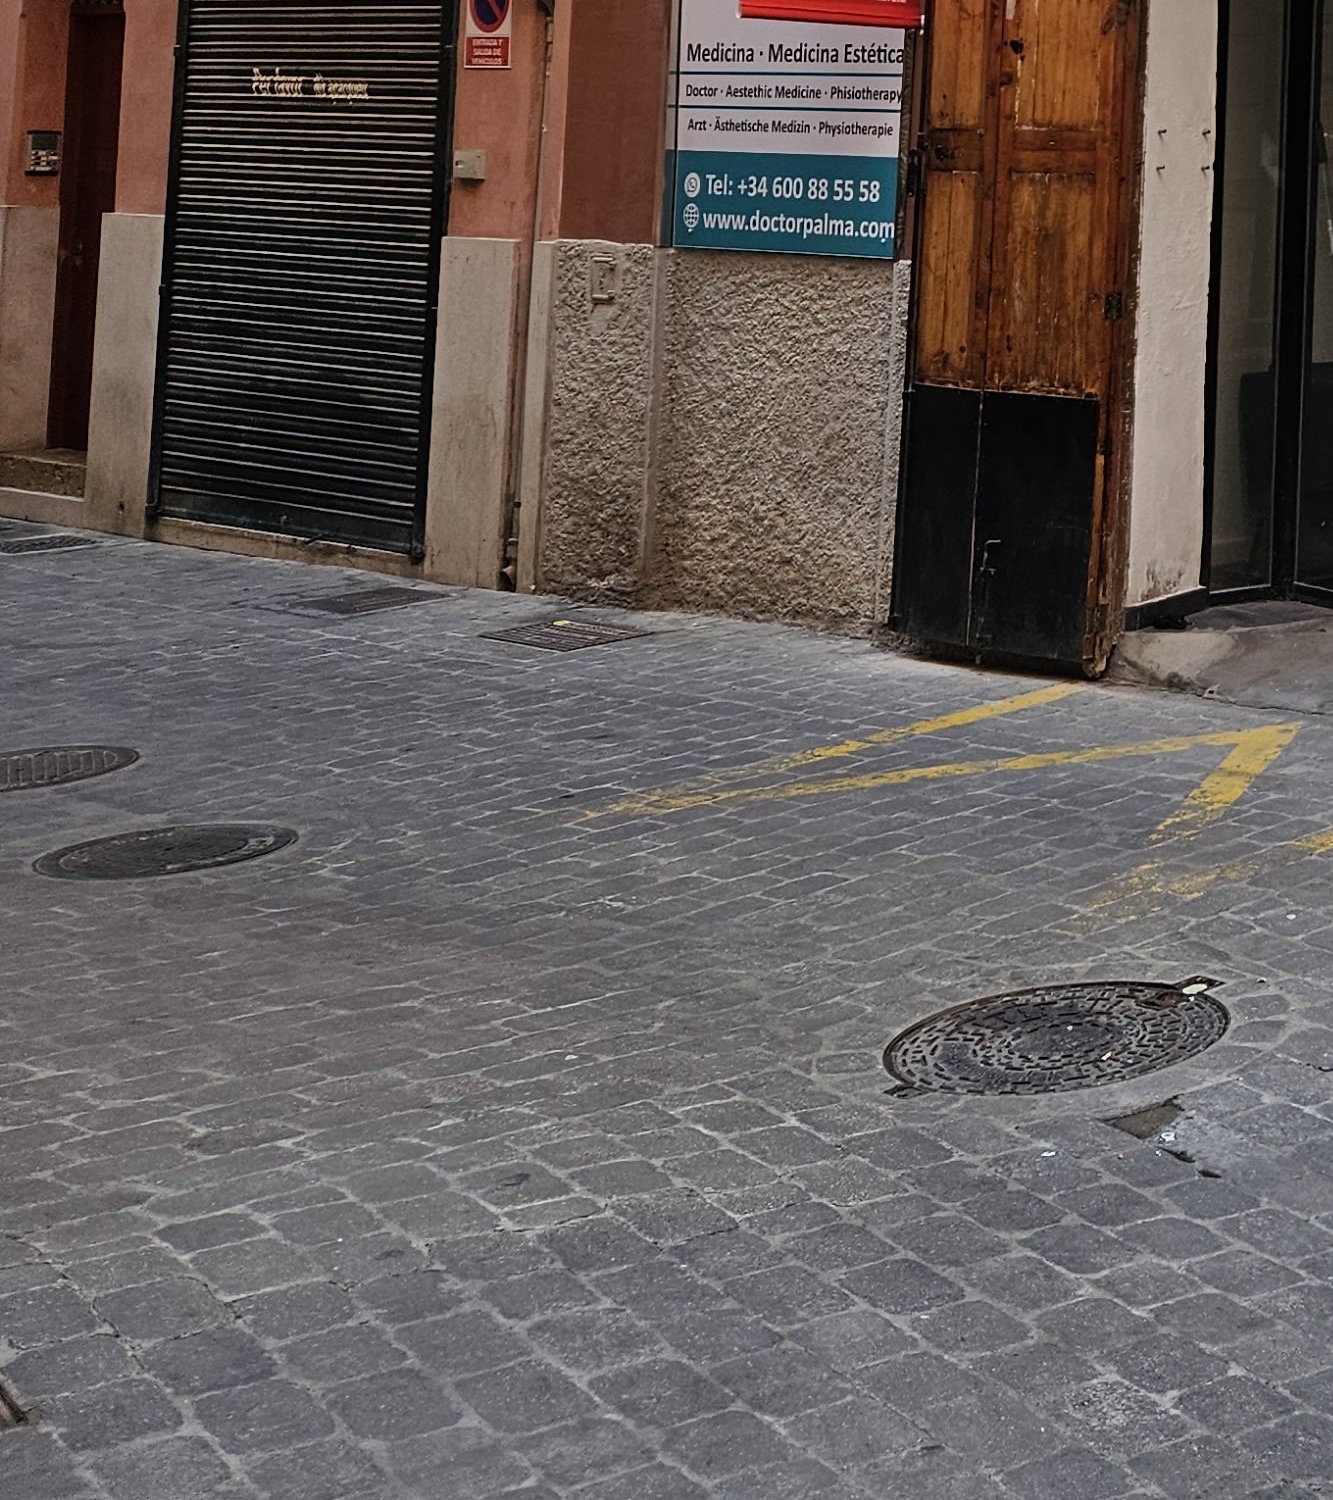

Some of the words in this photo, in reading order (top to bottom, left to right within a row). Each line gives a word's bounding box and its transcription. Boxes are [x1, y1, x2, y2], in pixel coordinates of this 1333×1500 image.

[686, 42, 754, 63] Medicina
[768, 42, 839, 63] Medicina
[844, 42, 904, 64] Estética
[685, 84, 718, 98] Doctor
[725, 84, 773, 99] Aestethic
[774, 85, 822, 100] Medicine
[830, 86, 902, 104] Phisiotherapy
[687, 118, 707, 131] Arzt
[714, 116, 769, 133] Ästhetische
[771, 120, 811, 134] Medizin
[818, 121, 893, 138] Physiotherapie
[705, 173, 733, 196] Tel:
[737, 175, 768, 198] +34
[772, 176, 804, 199] 600
[807, 178, 829, 200] 88
[833, 179, 854, 201] 55
[858, 180, 881, 203] 58
[703, 209, 895, 239] www.doctorpalma.com
